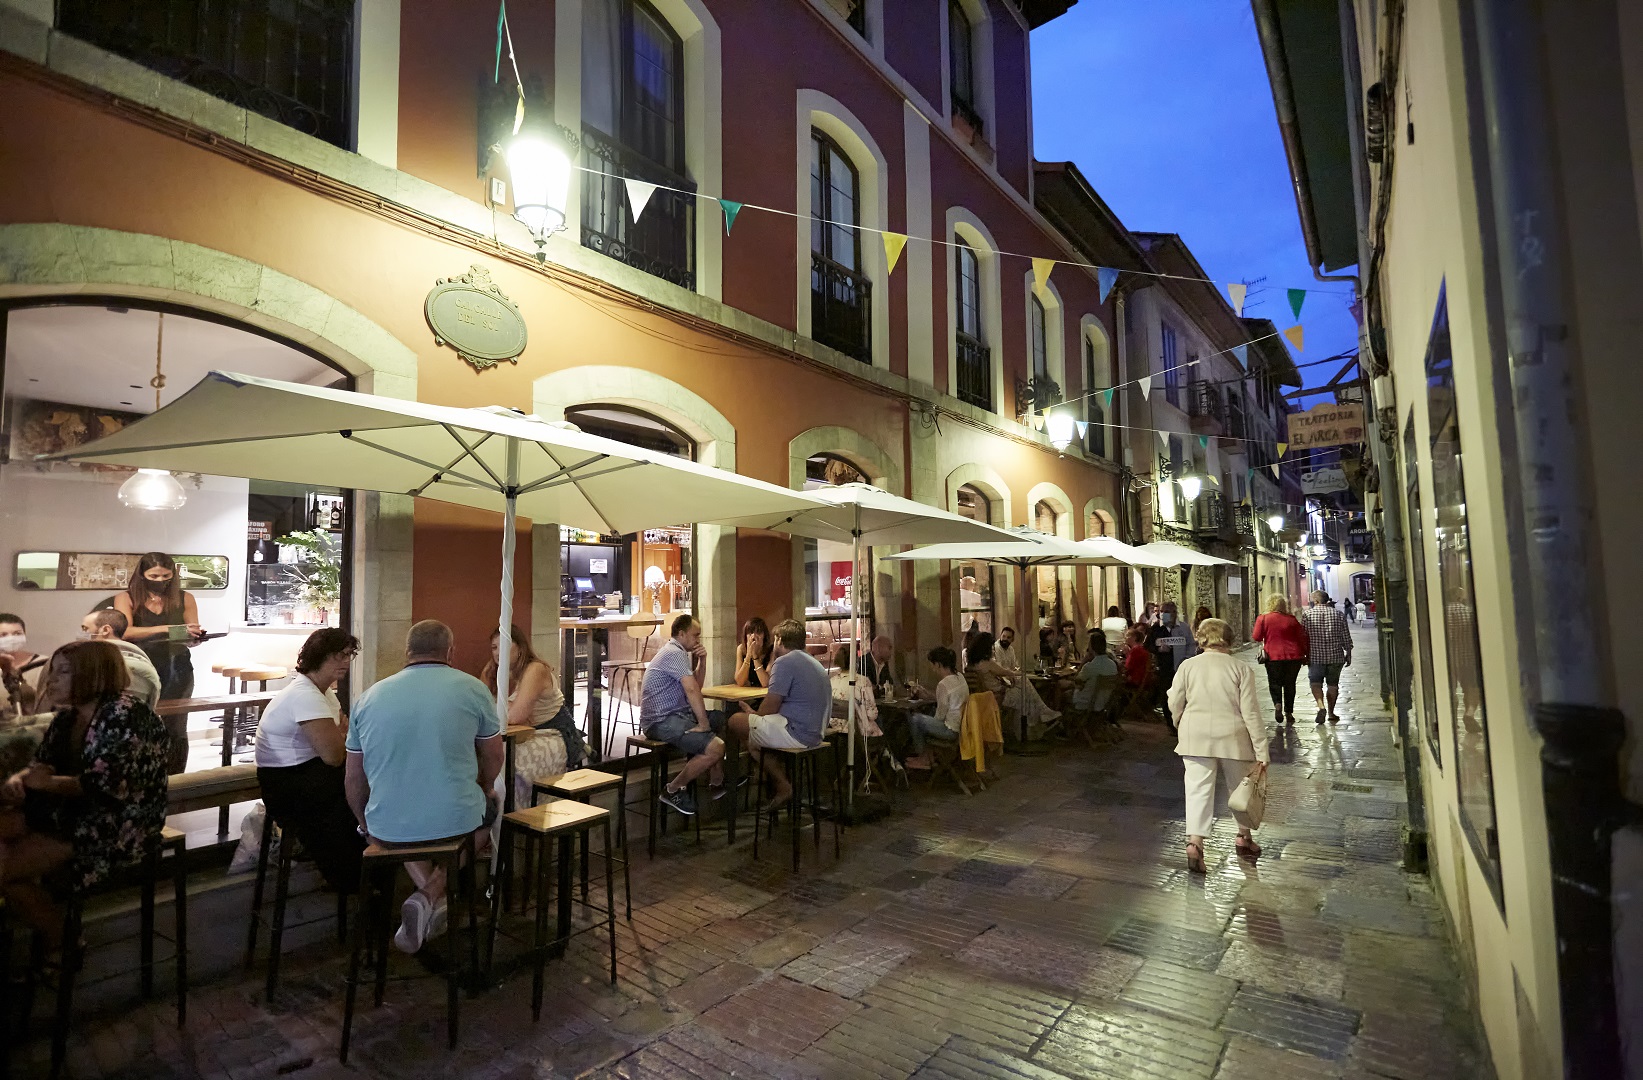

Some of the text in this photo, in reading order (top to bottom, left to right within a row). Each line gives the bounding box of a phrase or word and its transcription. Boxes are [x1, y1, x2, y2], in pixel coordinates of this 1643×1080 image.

[457, 312, 499, 332] DEL SOL
[1297, 410, 1354, 426] TRATTORIA
[1293, 429, 1339, 445] EL ARCA
[1312, 471, 1347, 489] Feeling
